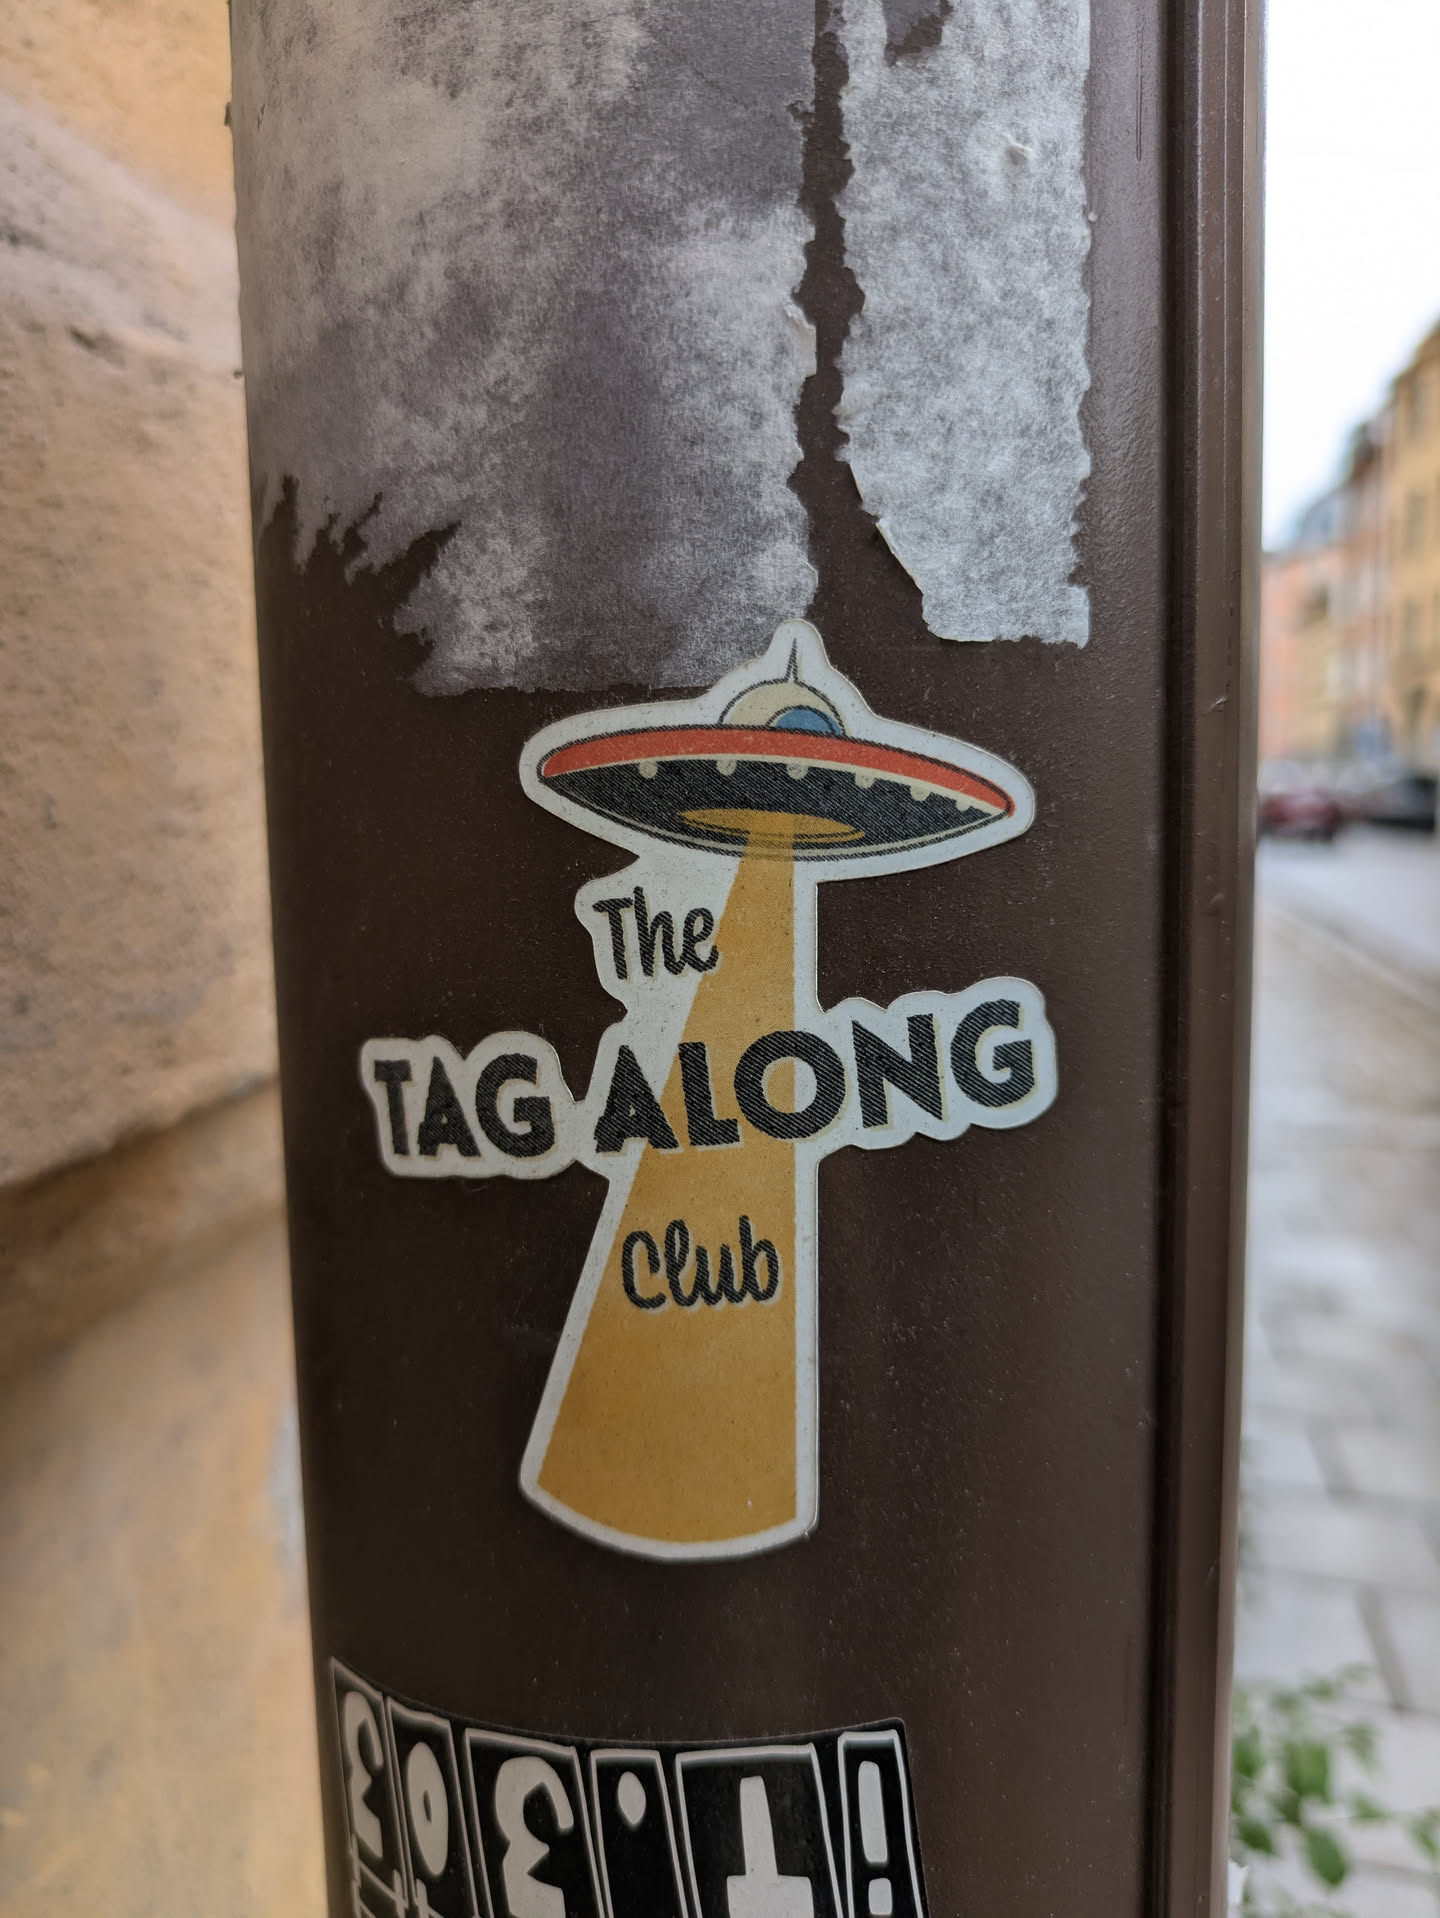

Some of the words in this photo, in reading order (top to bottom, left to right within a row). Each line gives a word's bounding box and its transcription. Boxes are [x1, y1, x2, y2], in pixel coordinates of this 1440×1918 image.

[592, 887, 719, 979] The
[374, 1052, 556, 1159] TAG
[594, 998, 1035, 1153] ALONG
